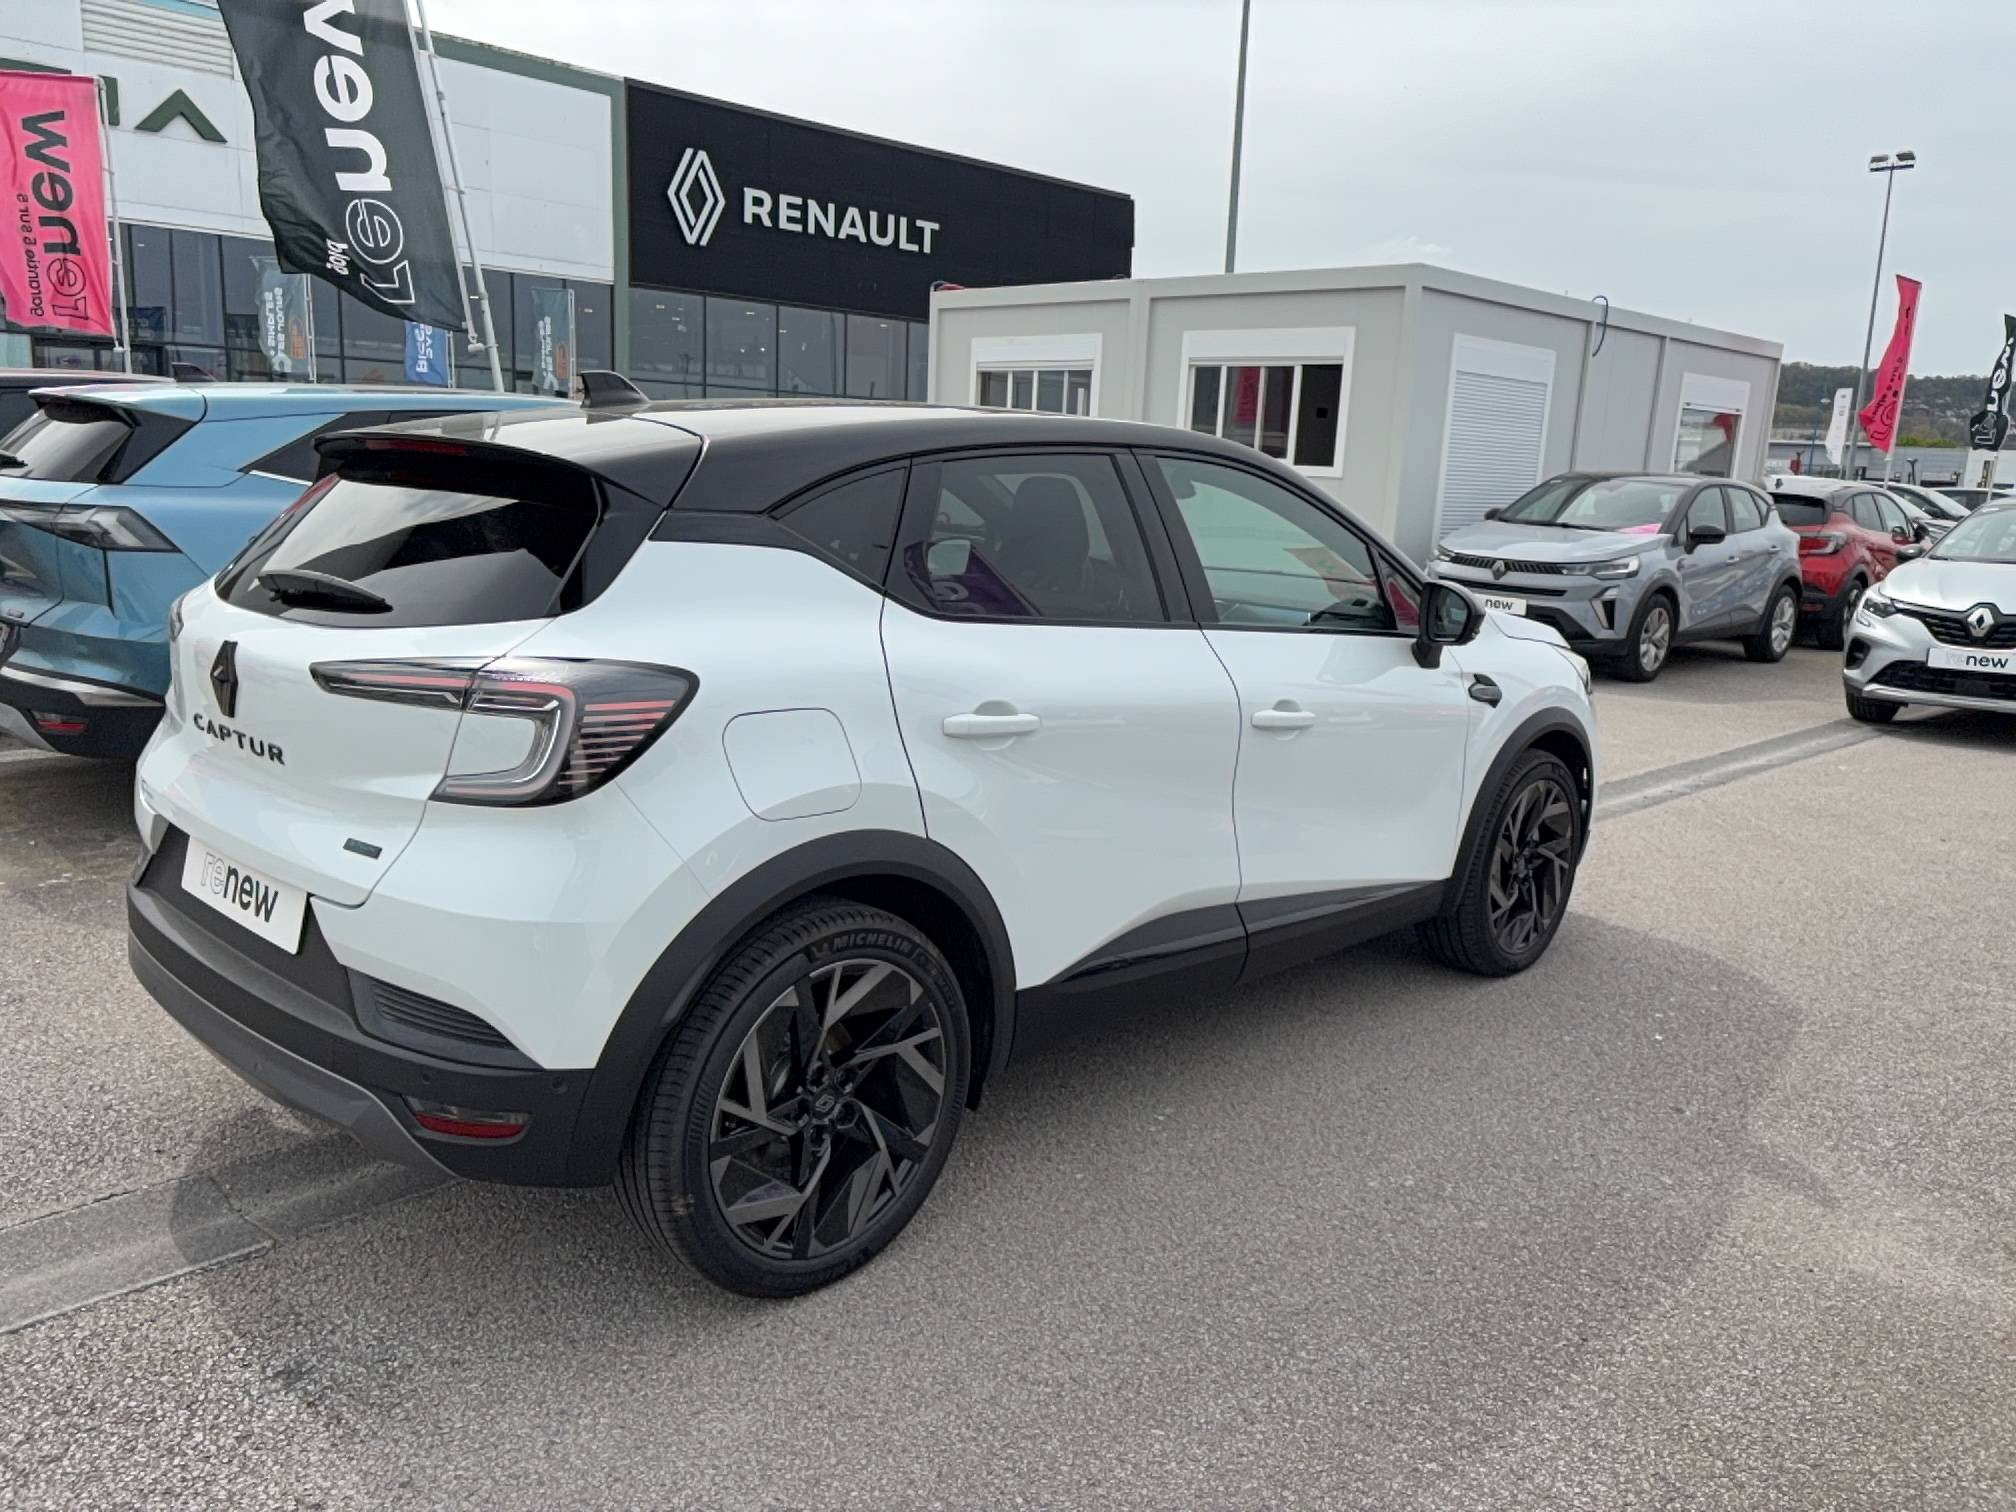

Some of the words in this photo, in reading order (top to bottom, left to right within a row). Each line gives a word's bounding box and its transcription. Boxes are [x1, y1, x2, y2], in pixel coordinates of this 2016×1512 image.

[743, 186, 940, 254] RENAULT
[193, 712, 286, 766] CAPTUR
[200, 851, 279, 923] renew
[831, 932, 914, 953] MICHELIN
